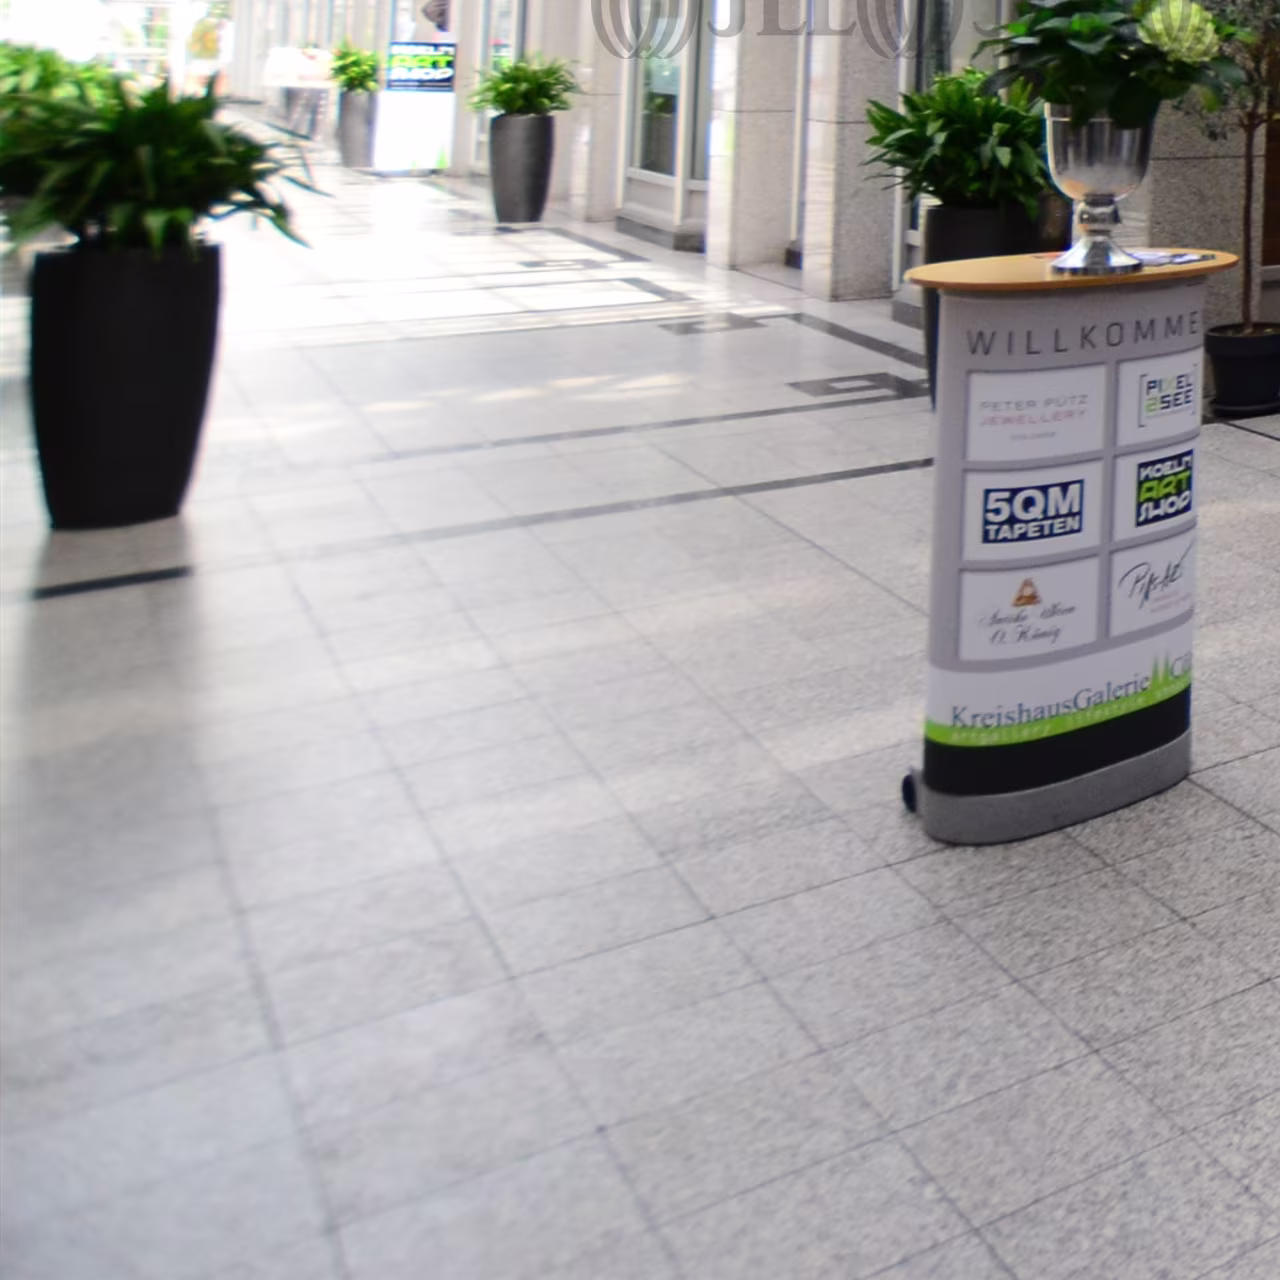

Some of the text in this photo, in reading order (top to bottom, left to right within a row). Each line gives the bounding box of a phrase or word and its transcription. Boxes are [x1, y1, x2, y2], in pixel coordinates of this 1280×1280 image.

[980, 399, 1037, 412] PETER
[1140, 470, 1190, 502] ART
[985, 483, 1081, 522] 5QM
[1138, 490, 1190, 522] SHOP
[985, 515, 1081, 541] TAPETEN
[950, 672, 1150, 729] KreishausGalerie
